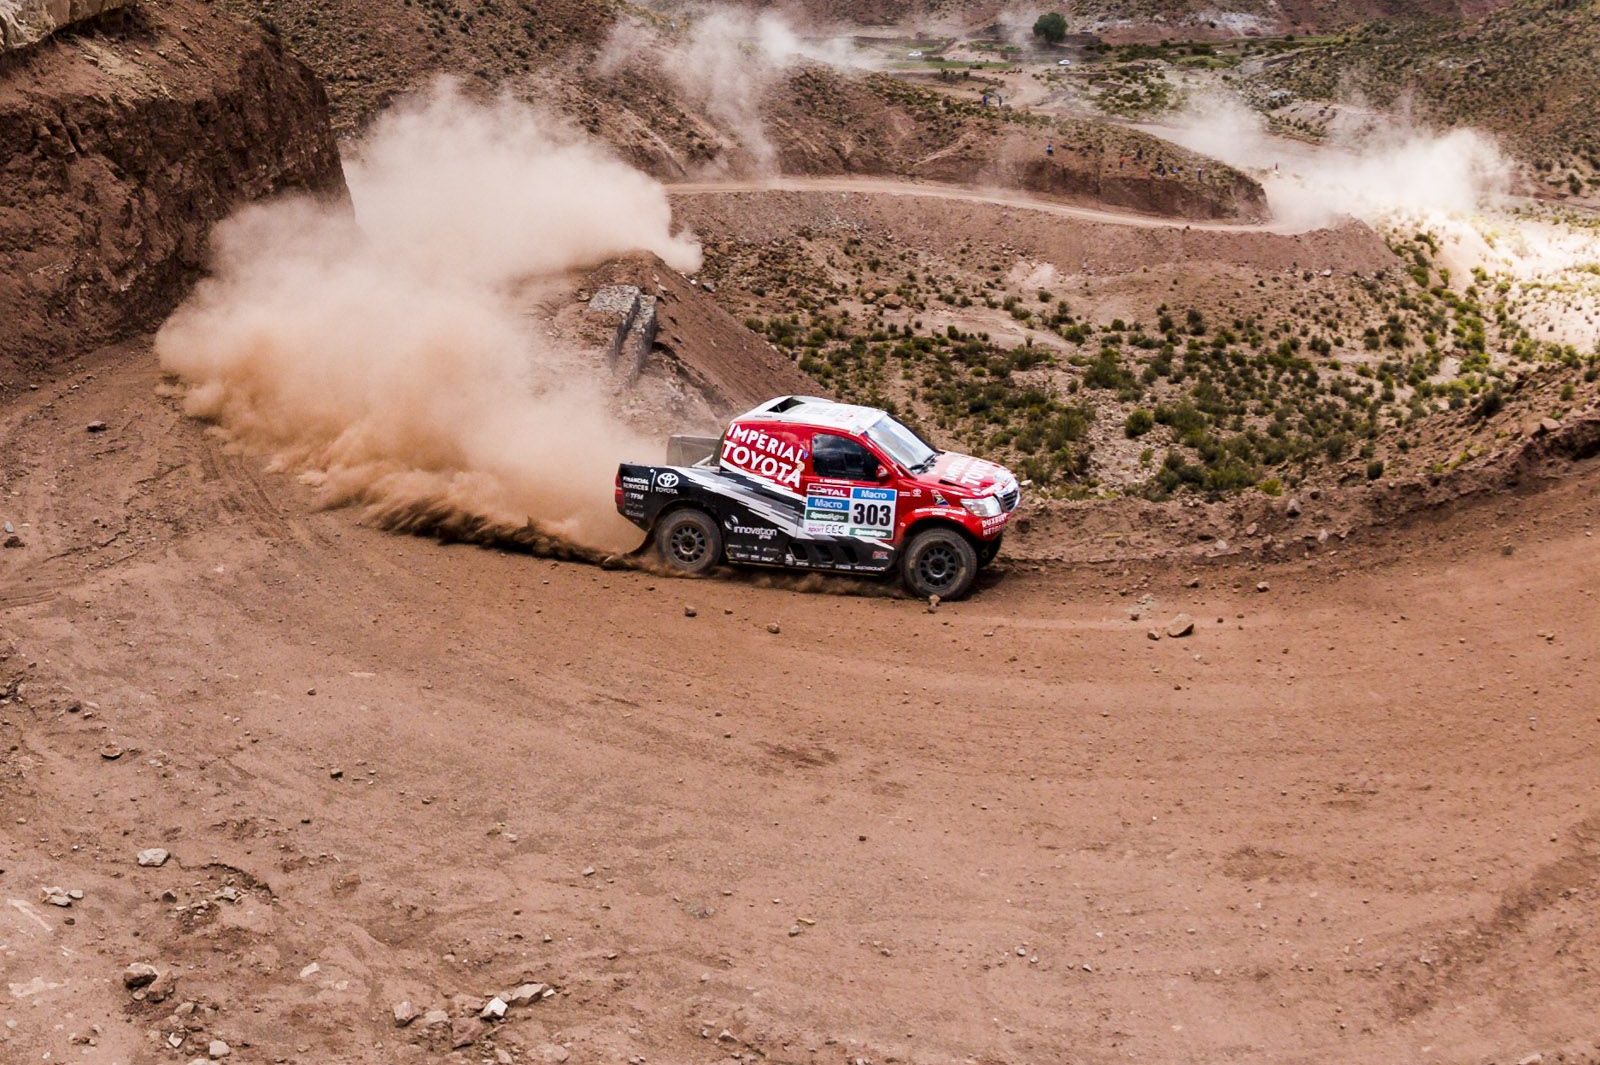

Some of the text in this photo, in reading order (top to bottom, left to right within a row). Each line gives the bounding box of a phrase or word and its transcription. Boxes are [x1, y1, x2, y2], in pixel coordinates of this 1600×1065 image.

[727, 423, 803, 463] IMPERIAL
[723, 440, 801, 488] TOYOTA
[623, 476, 649, 485] FINANCIAL
[623, 482, 649, 491] SERVICES
[655, 486, 678, 494] TOYOTA
[861, 490, 887, 499] Macro
[814, 499, 843, 509] Macro
[853, 503, 891, 526] 303
[734, 525, 777, 536] innovation
